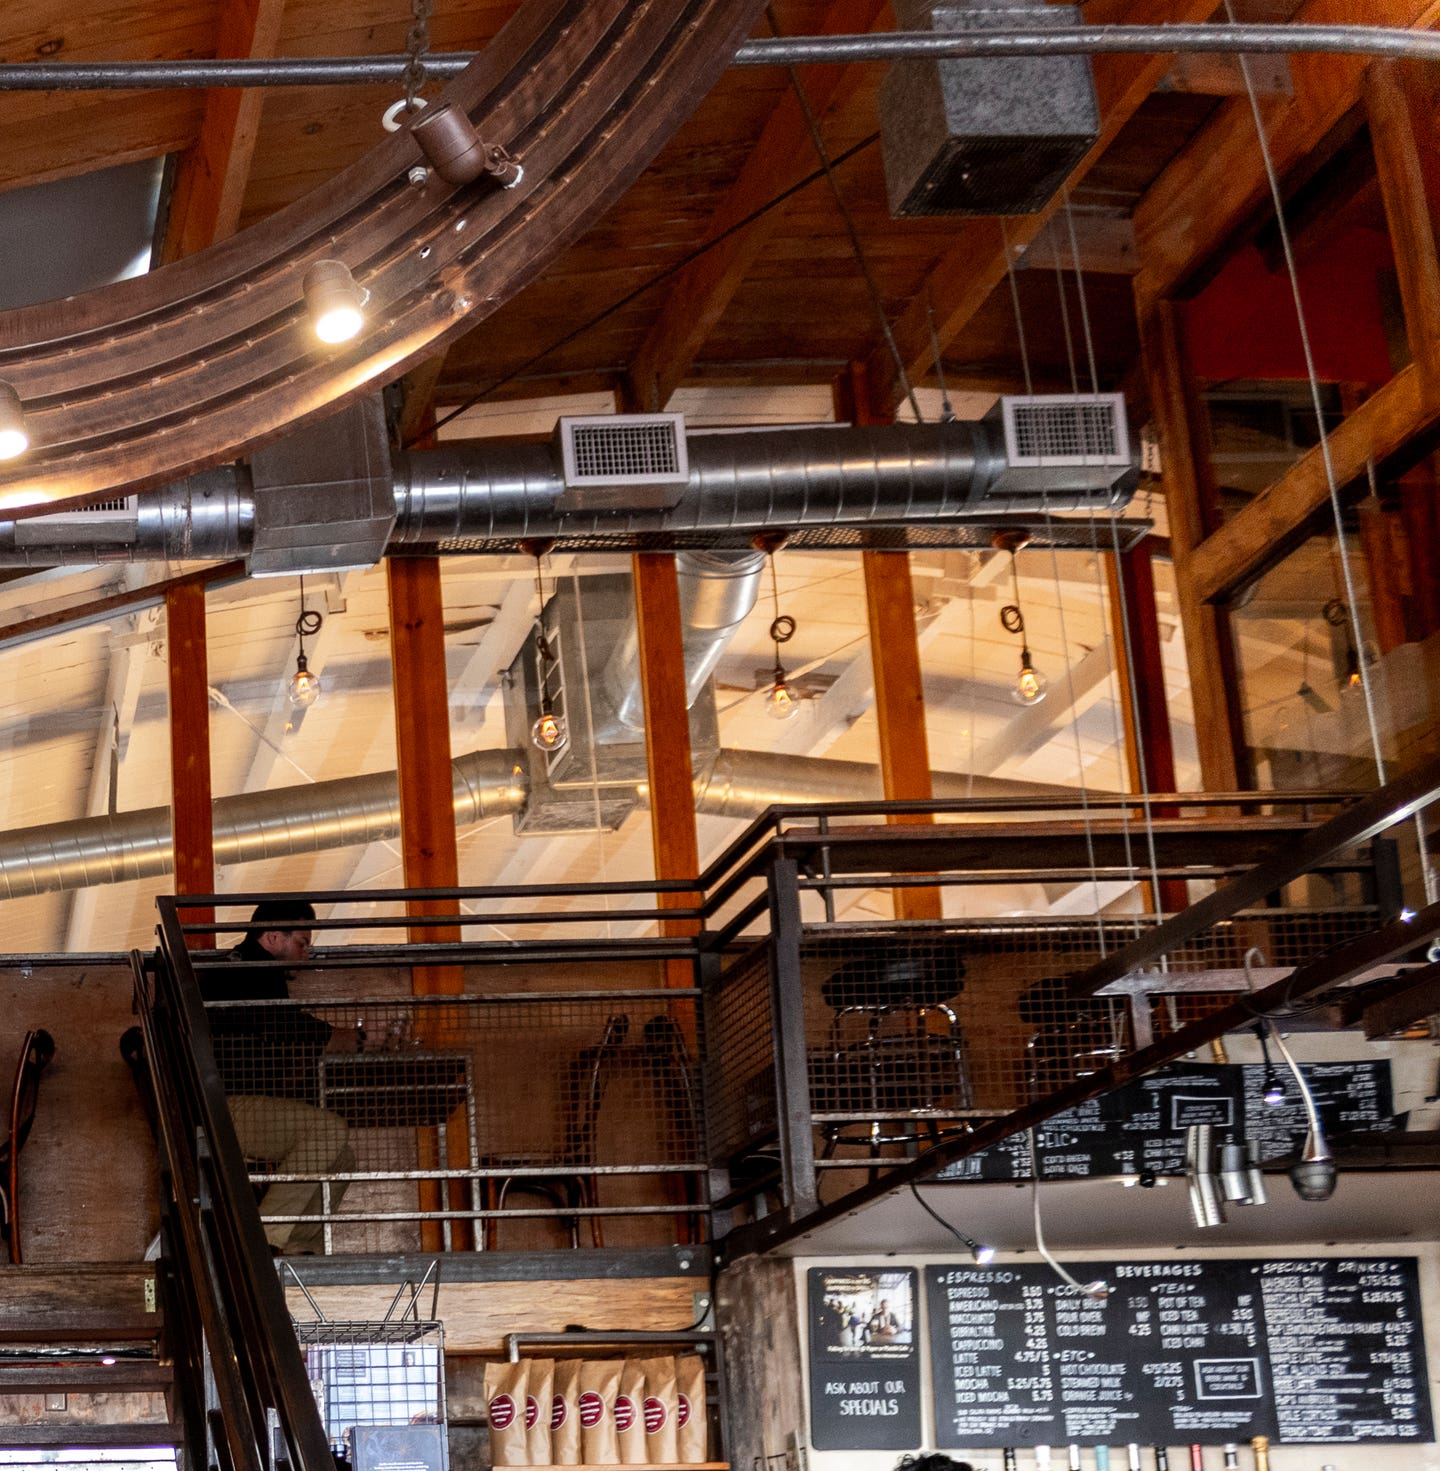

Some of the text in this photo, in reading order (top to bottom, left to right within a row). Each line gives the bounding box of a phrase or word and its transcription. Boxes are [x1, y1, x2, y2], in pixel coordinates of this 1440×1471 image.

[1115, 1264, 1203, 1278] BEVERAGES
[1262, 1261, 1389, 1274] SPECIALTY DRINKS
[946, 1271, 1013, 1284] ESPRESSO
[947, 1287, 989, 1300] ESPRESSO
[1158, 1283, 1186, 1294] TEA
[949, 1299, 999, 1312] AMERICANO
[1055, 1299, 1081, 1311] DAILY
[1158, 1297, 1175, 1309] POT
[1175, 1297, 1188, 1308] OF
[1159, 1310, 1180, 1322] ICED
[1180, 1310, 1200, 1321] TEA
[1024, 1325, 1047, 1336] 4.25
[1183, 1323, 1210, 1335] LATTE
[1025, 1338, 1048, 1350] 4.25
[1162, 1337, 1183, 1349] ICED
[953, 1352, 979, 1365] LATTE
[1060, 1350, 1088, 1362] ETC
[954, 1366, 975, 1378] ICED
[975, 1365, 1002, 1377] LATTE
[1060, 1363, 1078, 1376] HOT
[1077, 1363, 1127, 1375] CHOCOLATE
[825, 1380, 907, 1395] ASK ABOUT OUR
[955, 1378, 989, 1391] MOCHA
[1061, 1377, 1100, 1389] STEAMED
[1101, 1377, 1122, 1388] MILK
[956, 1392, 976, 1404] ICED
[977, 1391, 1010, 1403] MOCHA
[1062, 1390, 1097, 1402] ORANGE
[1098, 1390, 1123, 1401] JUICE
[839, 1399, 900, 1416] SPECIALS
